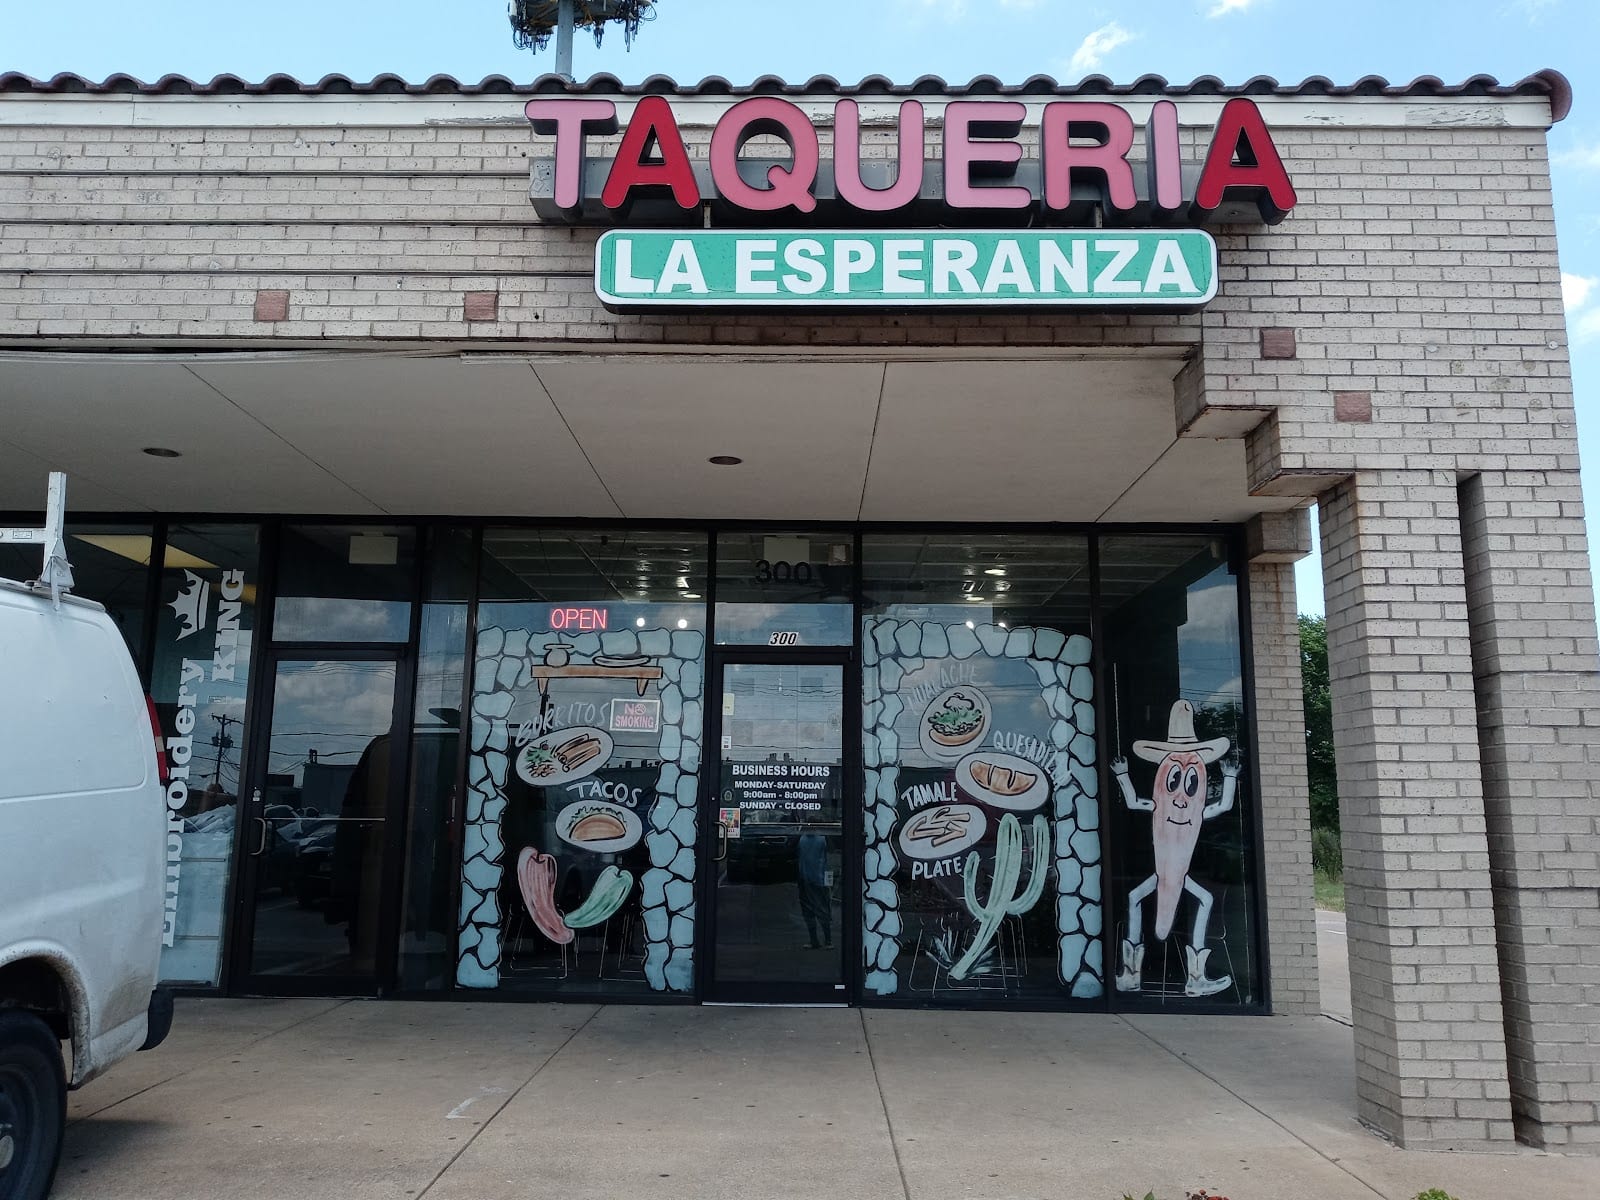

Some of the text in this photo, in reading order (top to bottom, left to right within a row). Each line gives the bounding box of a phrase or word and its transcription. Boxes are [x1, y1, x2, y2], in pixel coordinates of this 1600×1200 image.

[523, 95, 1298, 213] TAQUERIA
[613, 237, 1202, 295] LA ESPERANZA
[755, 560, 811, 584] 300
[211, 568, 245, 682] KING
[551, 608, 607, 629] OPEN
[770, 632, 797, 645] 300
[624, 703, 648, 715] NO
[515, 701, 610, 747] BURRITOS
[615, 715, 654, 729] SMOKING
[732, 764, 830, 777] BUSINESS HOURS
[566, 780, 642, 808] TACOS
[734, 780, 827, 790] MONDAY-SATURDAY
[743, 790, 777, 799] 9:00am
[784, 790, 818, 800] 8:00pm
[901, 781, 959, 811] TAMALE
[739, 801, 777, 810] SUNDAY
[784, 802, 821, 811] CLOSED
[911, 856, 963, 881] PLATE
